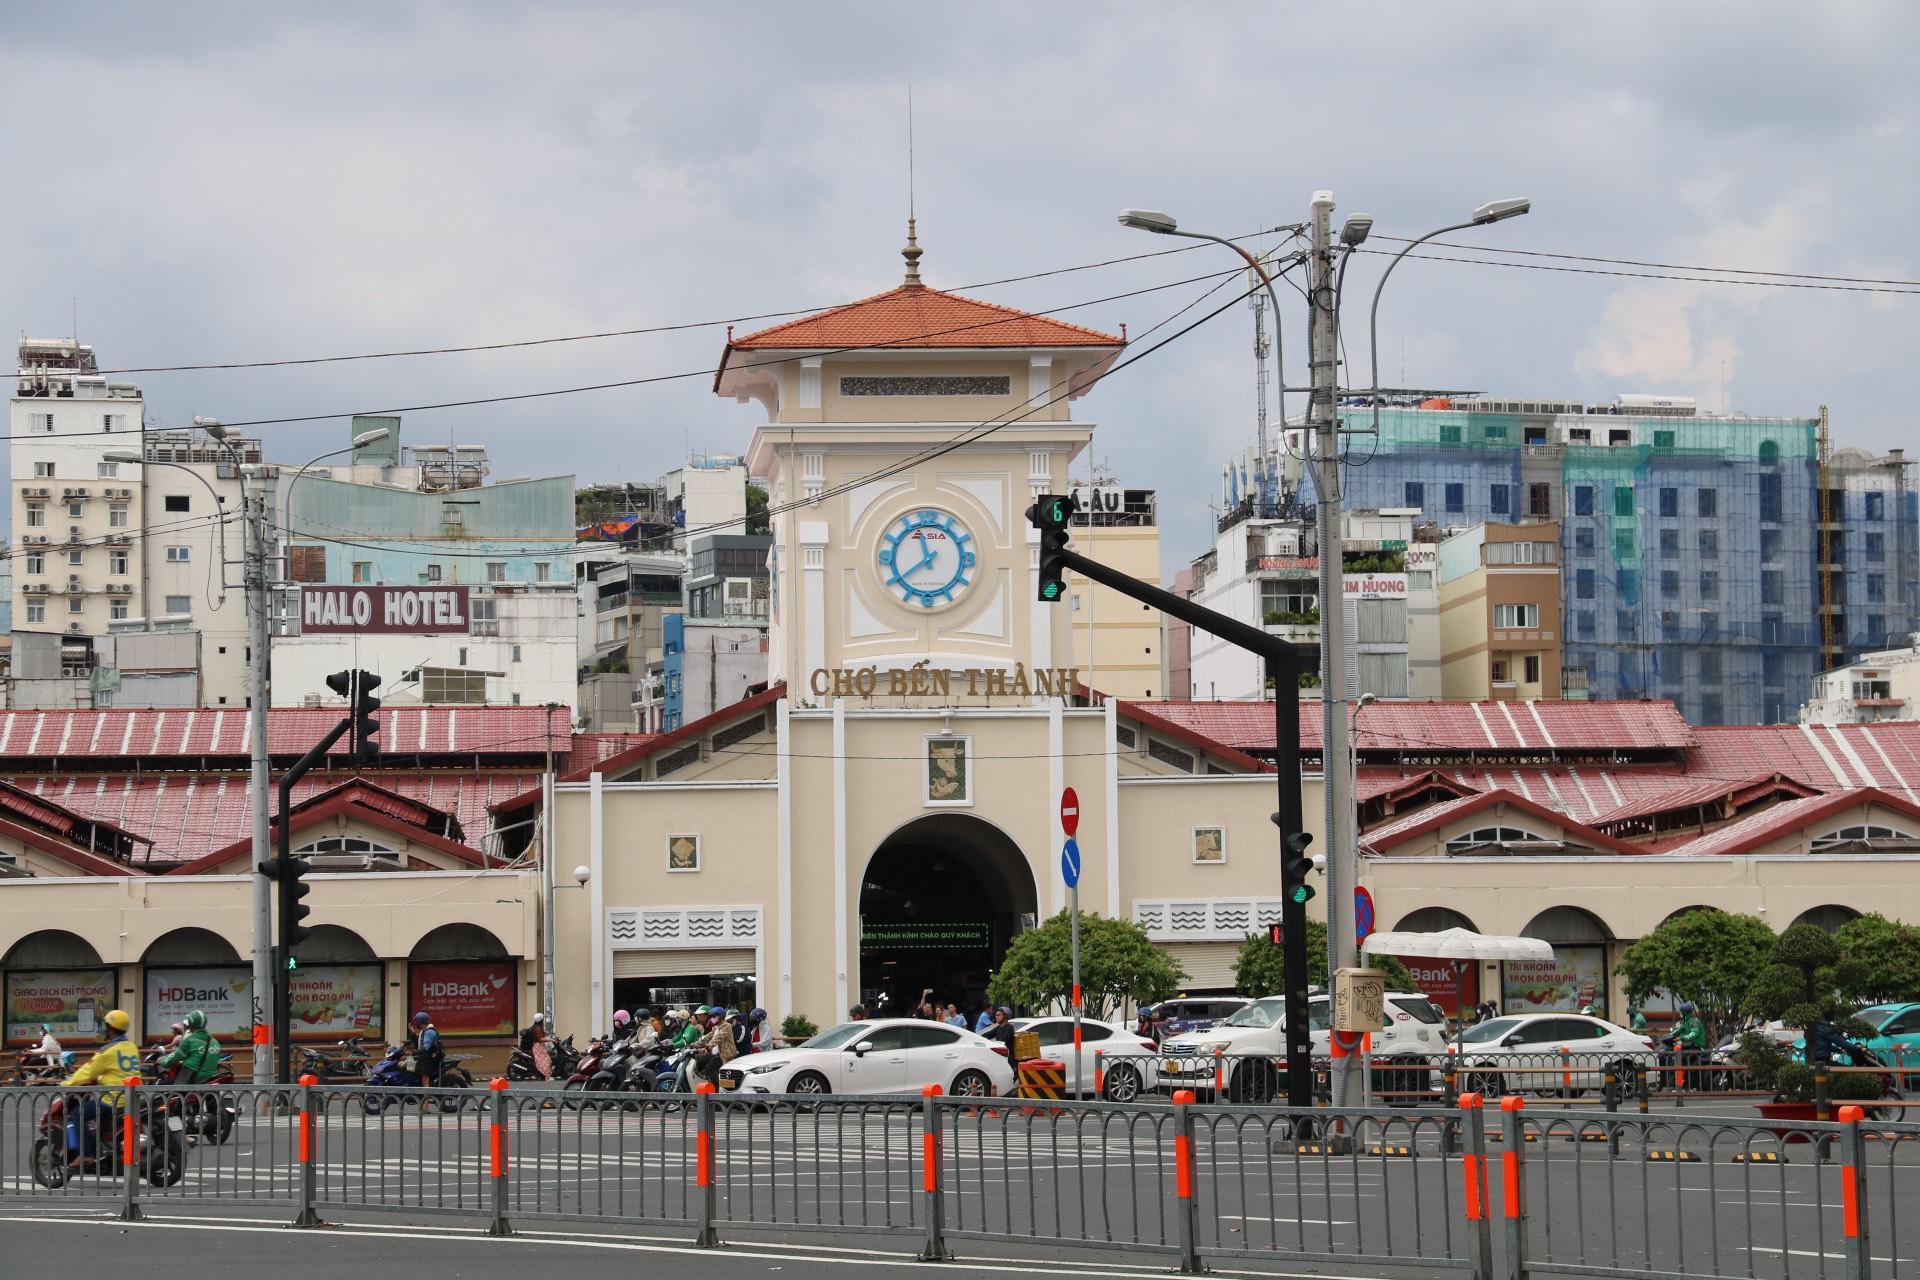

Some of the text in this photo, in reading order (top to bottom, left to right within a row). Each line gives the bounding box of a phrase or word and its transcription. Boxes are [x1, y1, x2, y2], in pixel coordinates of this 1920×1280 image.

[1053, 501, 1063, 522] 6
[911, 529, 947, 540] ASIA
[962, 551, 976, 569] 3
[1362, 580, 1405, 593] HUONG
[305, 590, 465, 626] HALO HOTEL
[811, 659, 1080, 700] CHỢ BẾN THÀNH
[1410, 967, 1451, 981] Bank
[158, 987, 229, 1001] HDBank
[422, 982, 489, 996] HDBank
[117, 1050, 140, 1072] be
